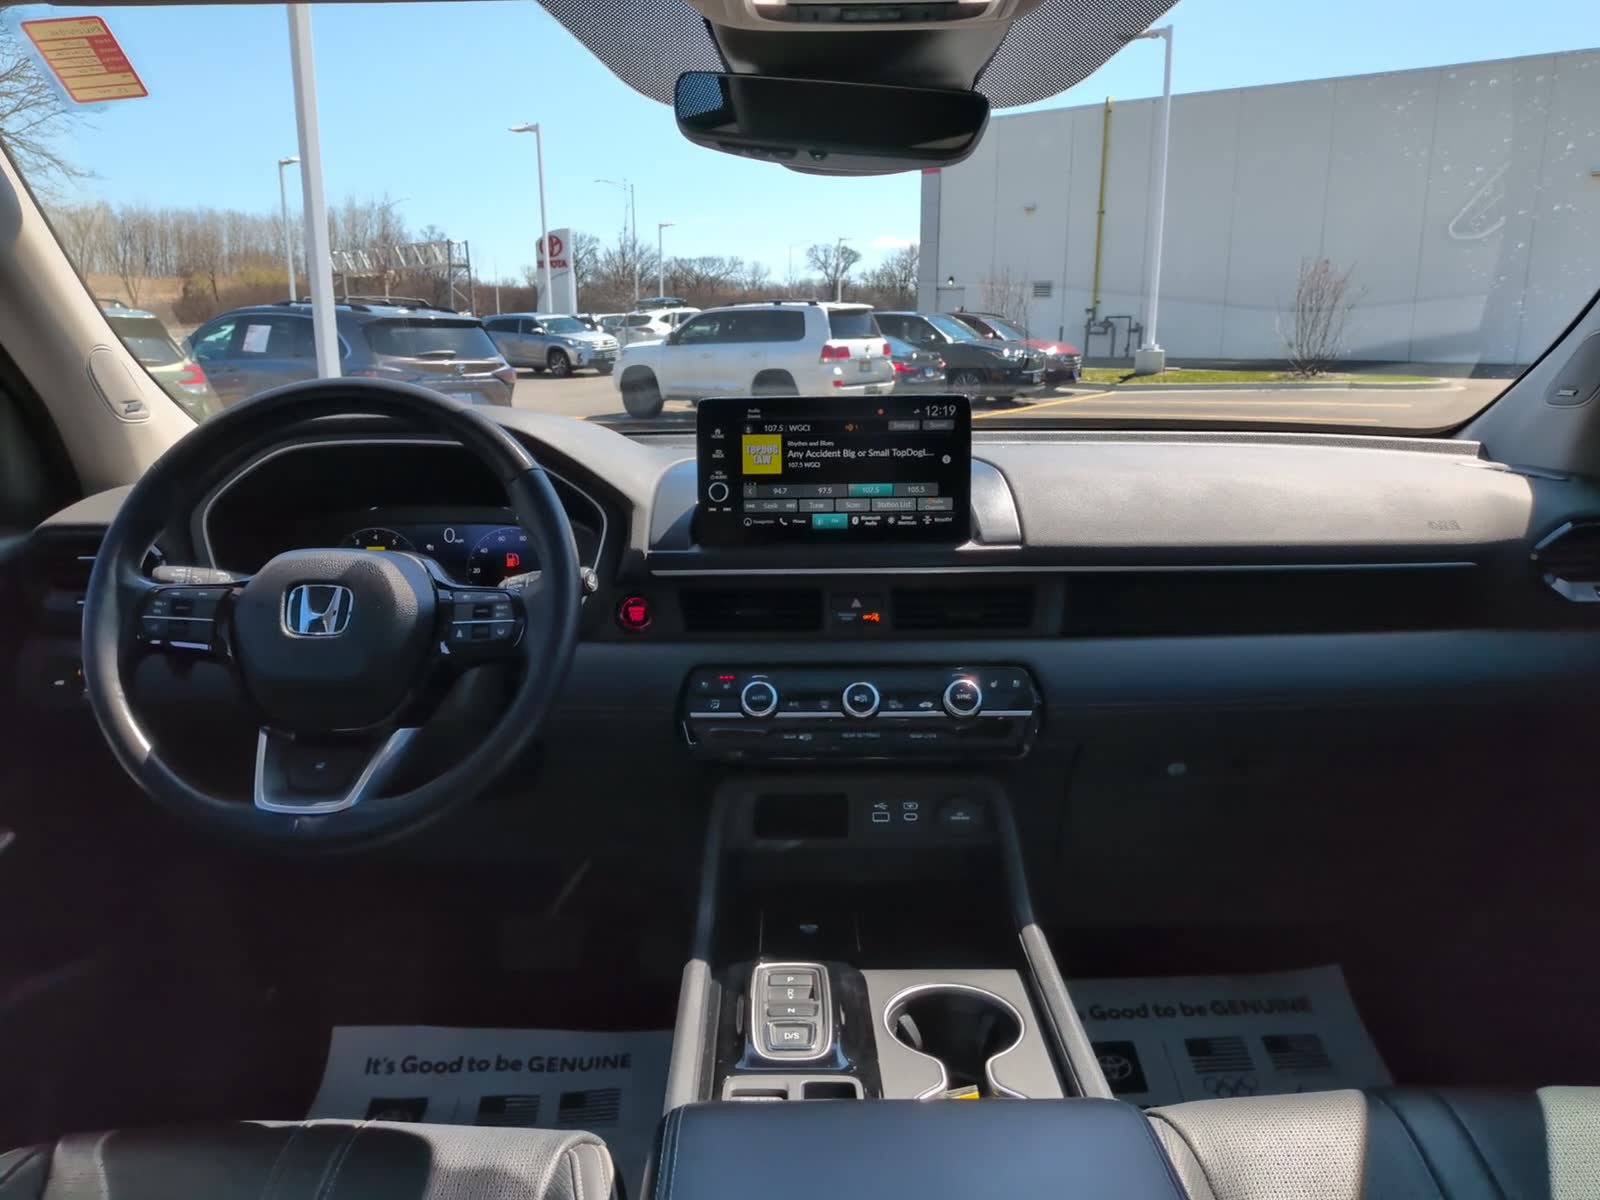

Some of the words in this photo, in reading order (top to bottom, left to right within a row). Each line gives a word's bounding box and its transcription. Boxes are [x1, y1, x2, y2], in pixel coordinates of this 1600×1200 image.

[924, 404, 956, 417] 12:19
[787, 450, 804, 459] Any
[806, 449, 841, 458] Accident
[842, 449, 856, 459] Big
[868, 448, 890, 457] Small
[862, 486, 879, 494] 107.5
[877, 500, 899, 508] Station
[900, 499, 912, 508] List
[444, 528, 456, 543] 0
[472, 567, 480, 575] 20
[1089, 1003, 1149, 1020] Good
[1152, 1004, 1177, 1019] to
[1180, 1002, 1208, 1017] be
[1210, 996, 1313, 1017] GENUINE
[784, 1032, 800, 1040] D/S
[365, 1056, 397, 1076] It's
[401, 1055, 464, 1075] Good
[467, 1056, 491, 1073] to
[495, 1054, 523, 1073] be
[527, 1052, 633, 1073] GENUINE
